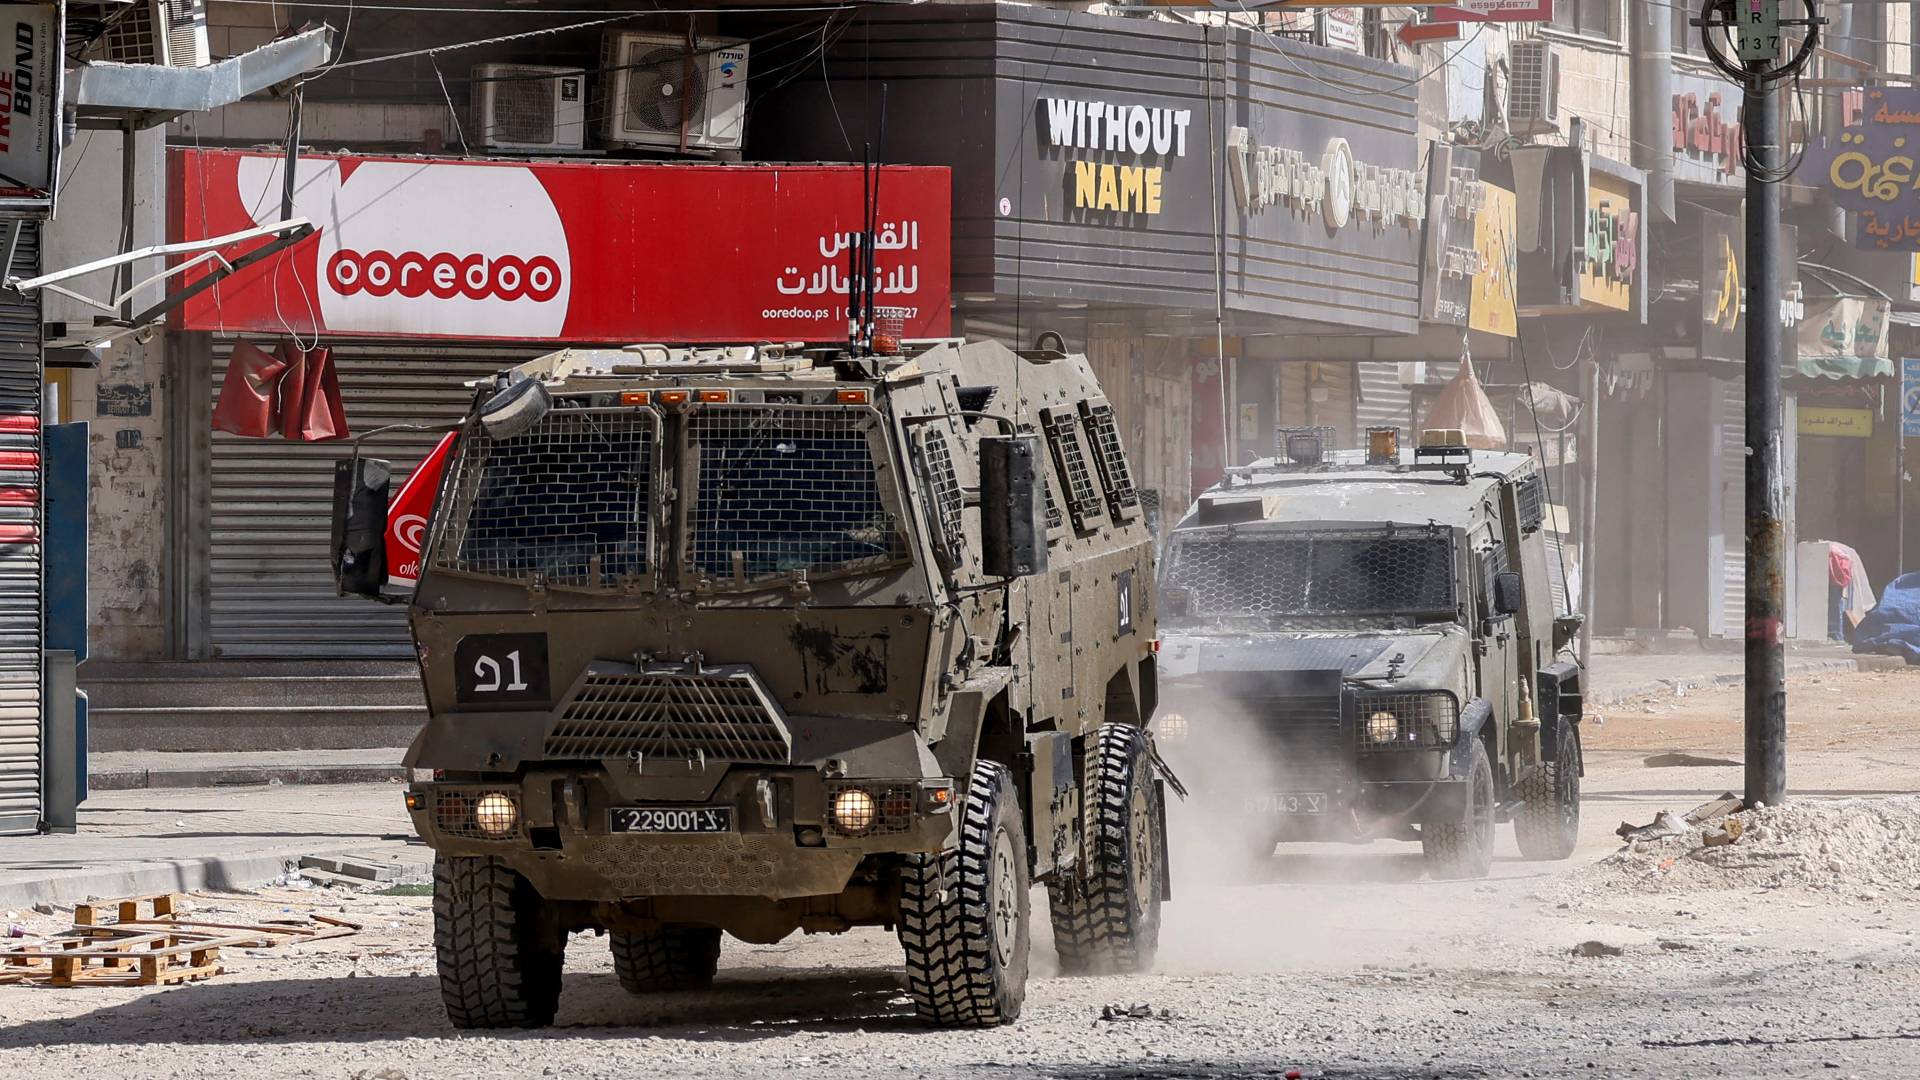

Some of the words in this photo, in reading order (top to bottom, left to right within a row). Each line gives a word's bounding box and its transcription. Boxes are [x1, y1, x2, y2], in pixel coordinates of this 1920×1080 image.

[1751, 12, 1762, 24] R
[14, 21, 34, 117] BOND
[1046, 97, 1192, 158] WITHOUT
[1074, 159, 1163, 215] NAME
[819, 210, 919, 258] القس
[331, 252, 557, 297] ooredoo
[762, 306, 829, 321] ooredoo.ps
